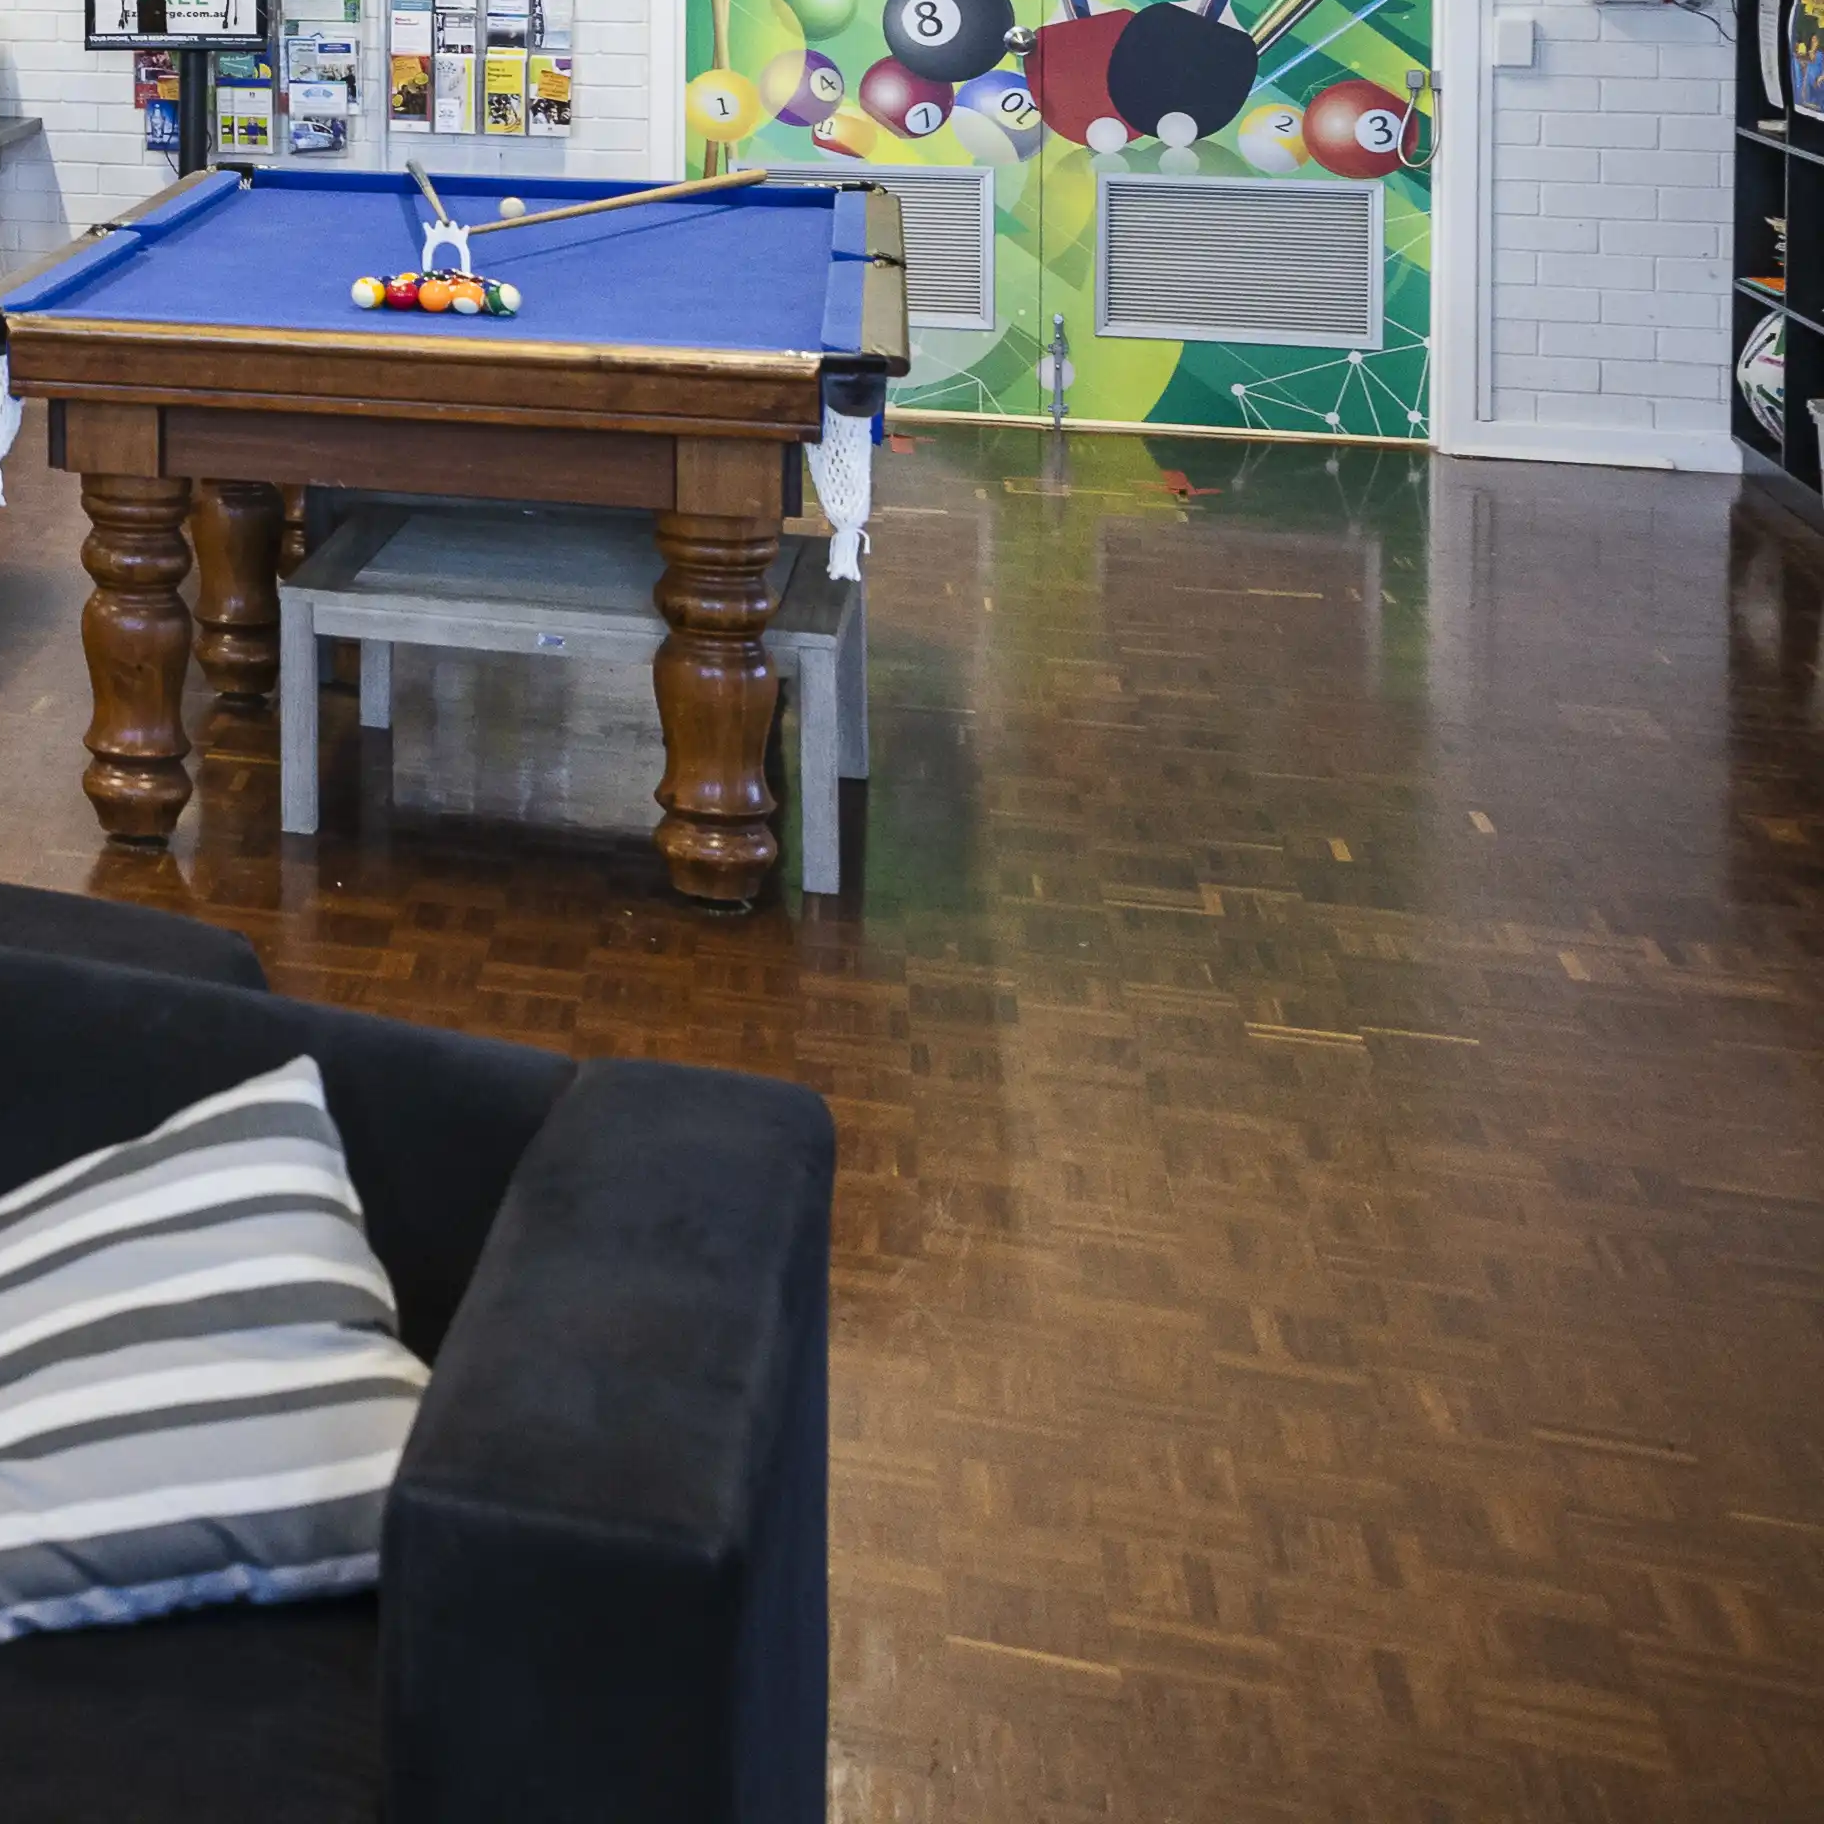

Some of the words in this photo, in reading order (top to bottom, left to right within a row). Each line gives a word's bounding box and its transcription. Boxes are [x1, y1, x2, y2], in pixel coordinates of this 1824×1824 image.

[914, 1, 943, 37] 8
[819, 75, 837, 92] 4
[716, 97, 730, 116] 1
[912, 107, 934, 129] 7
[1274, 115, 1294, 133] 2
[817, 120, 835, 136] 11
[1369, 115, 1393, 146] 3
